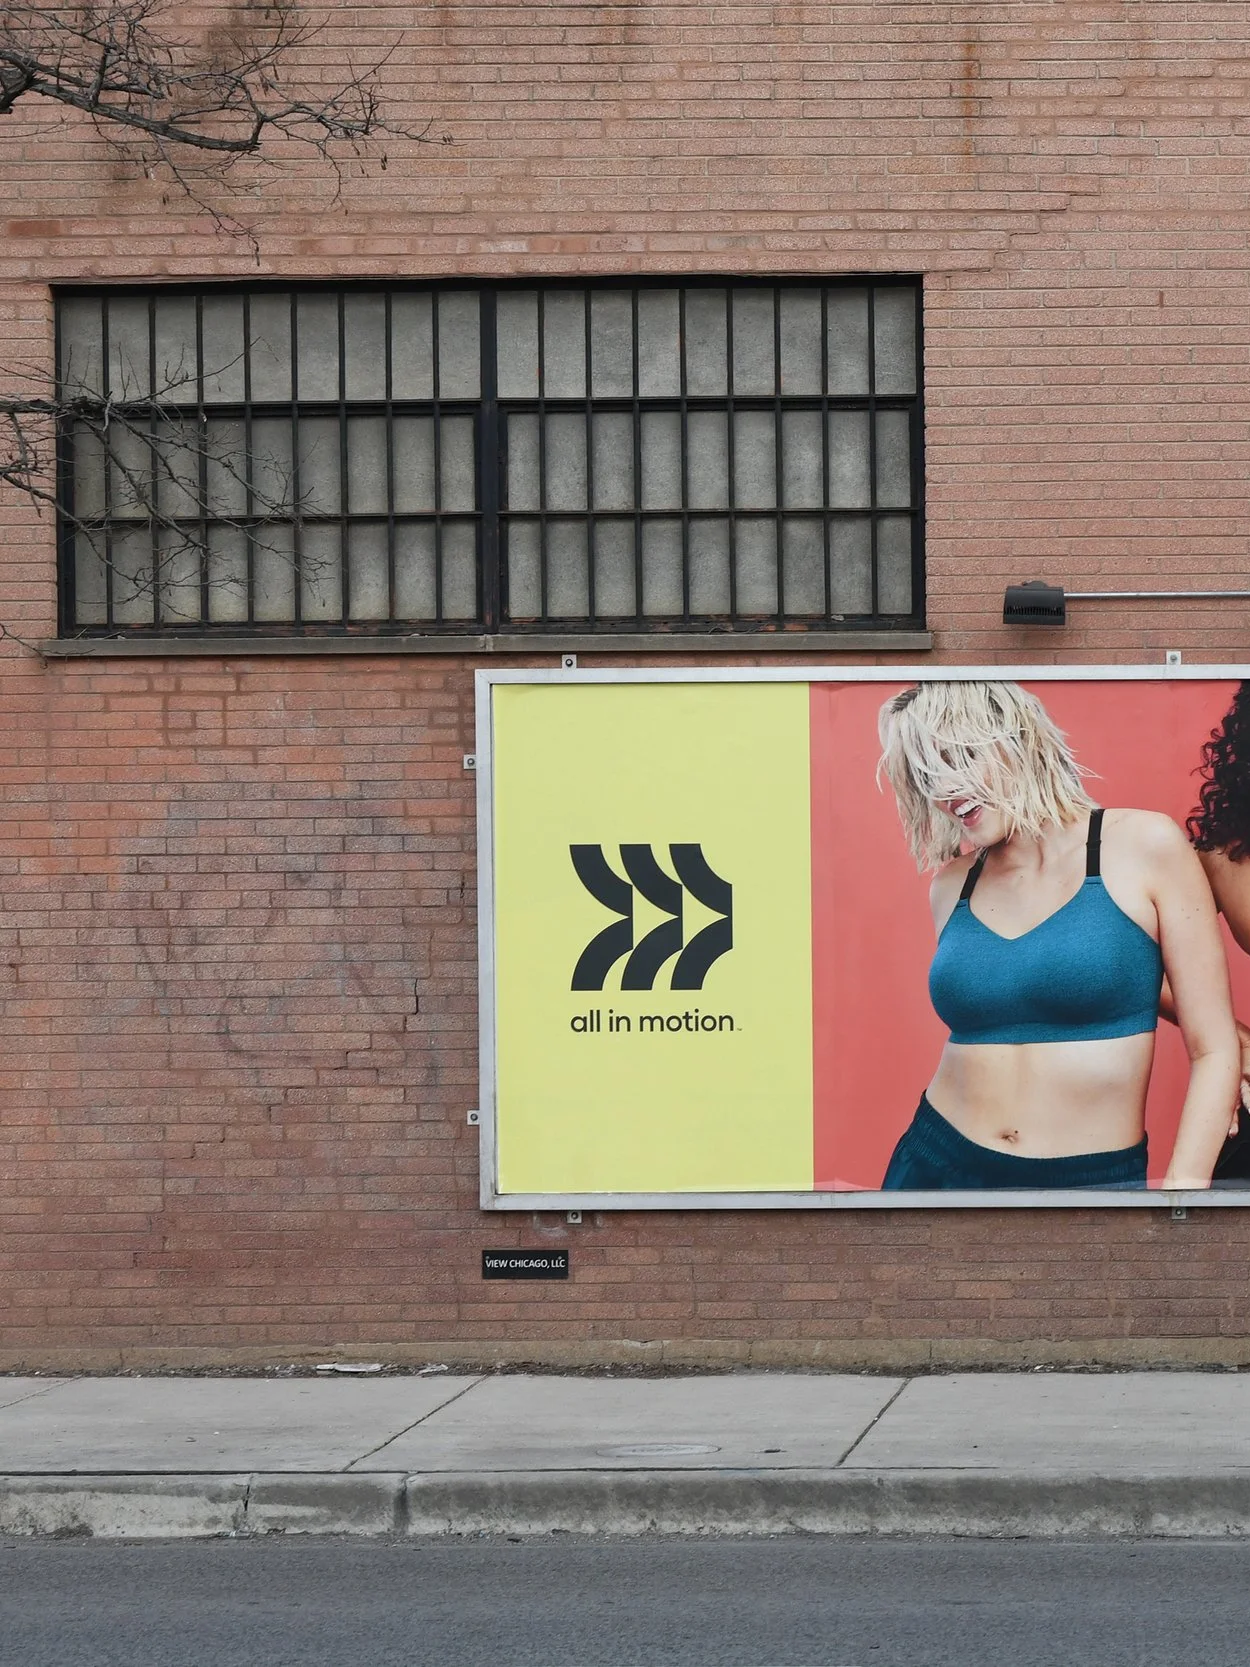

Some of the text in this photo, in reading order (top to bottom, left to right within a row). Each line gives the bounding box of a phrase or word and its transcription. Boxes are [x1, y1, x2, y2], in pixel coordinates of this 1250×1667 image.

[570, 1008, 735, 1033] all in motion
[485, 1259, 566, 1269] VIEW CHICAGO, LLC
